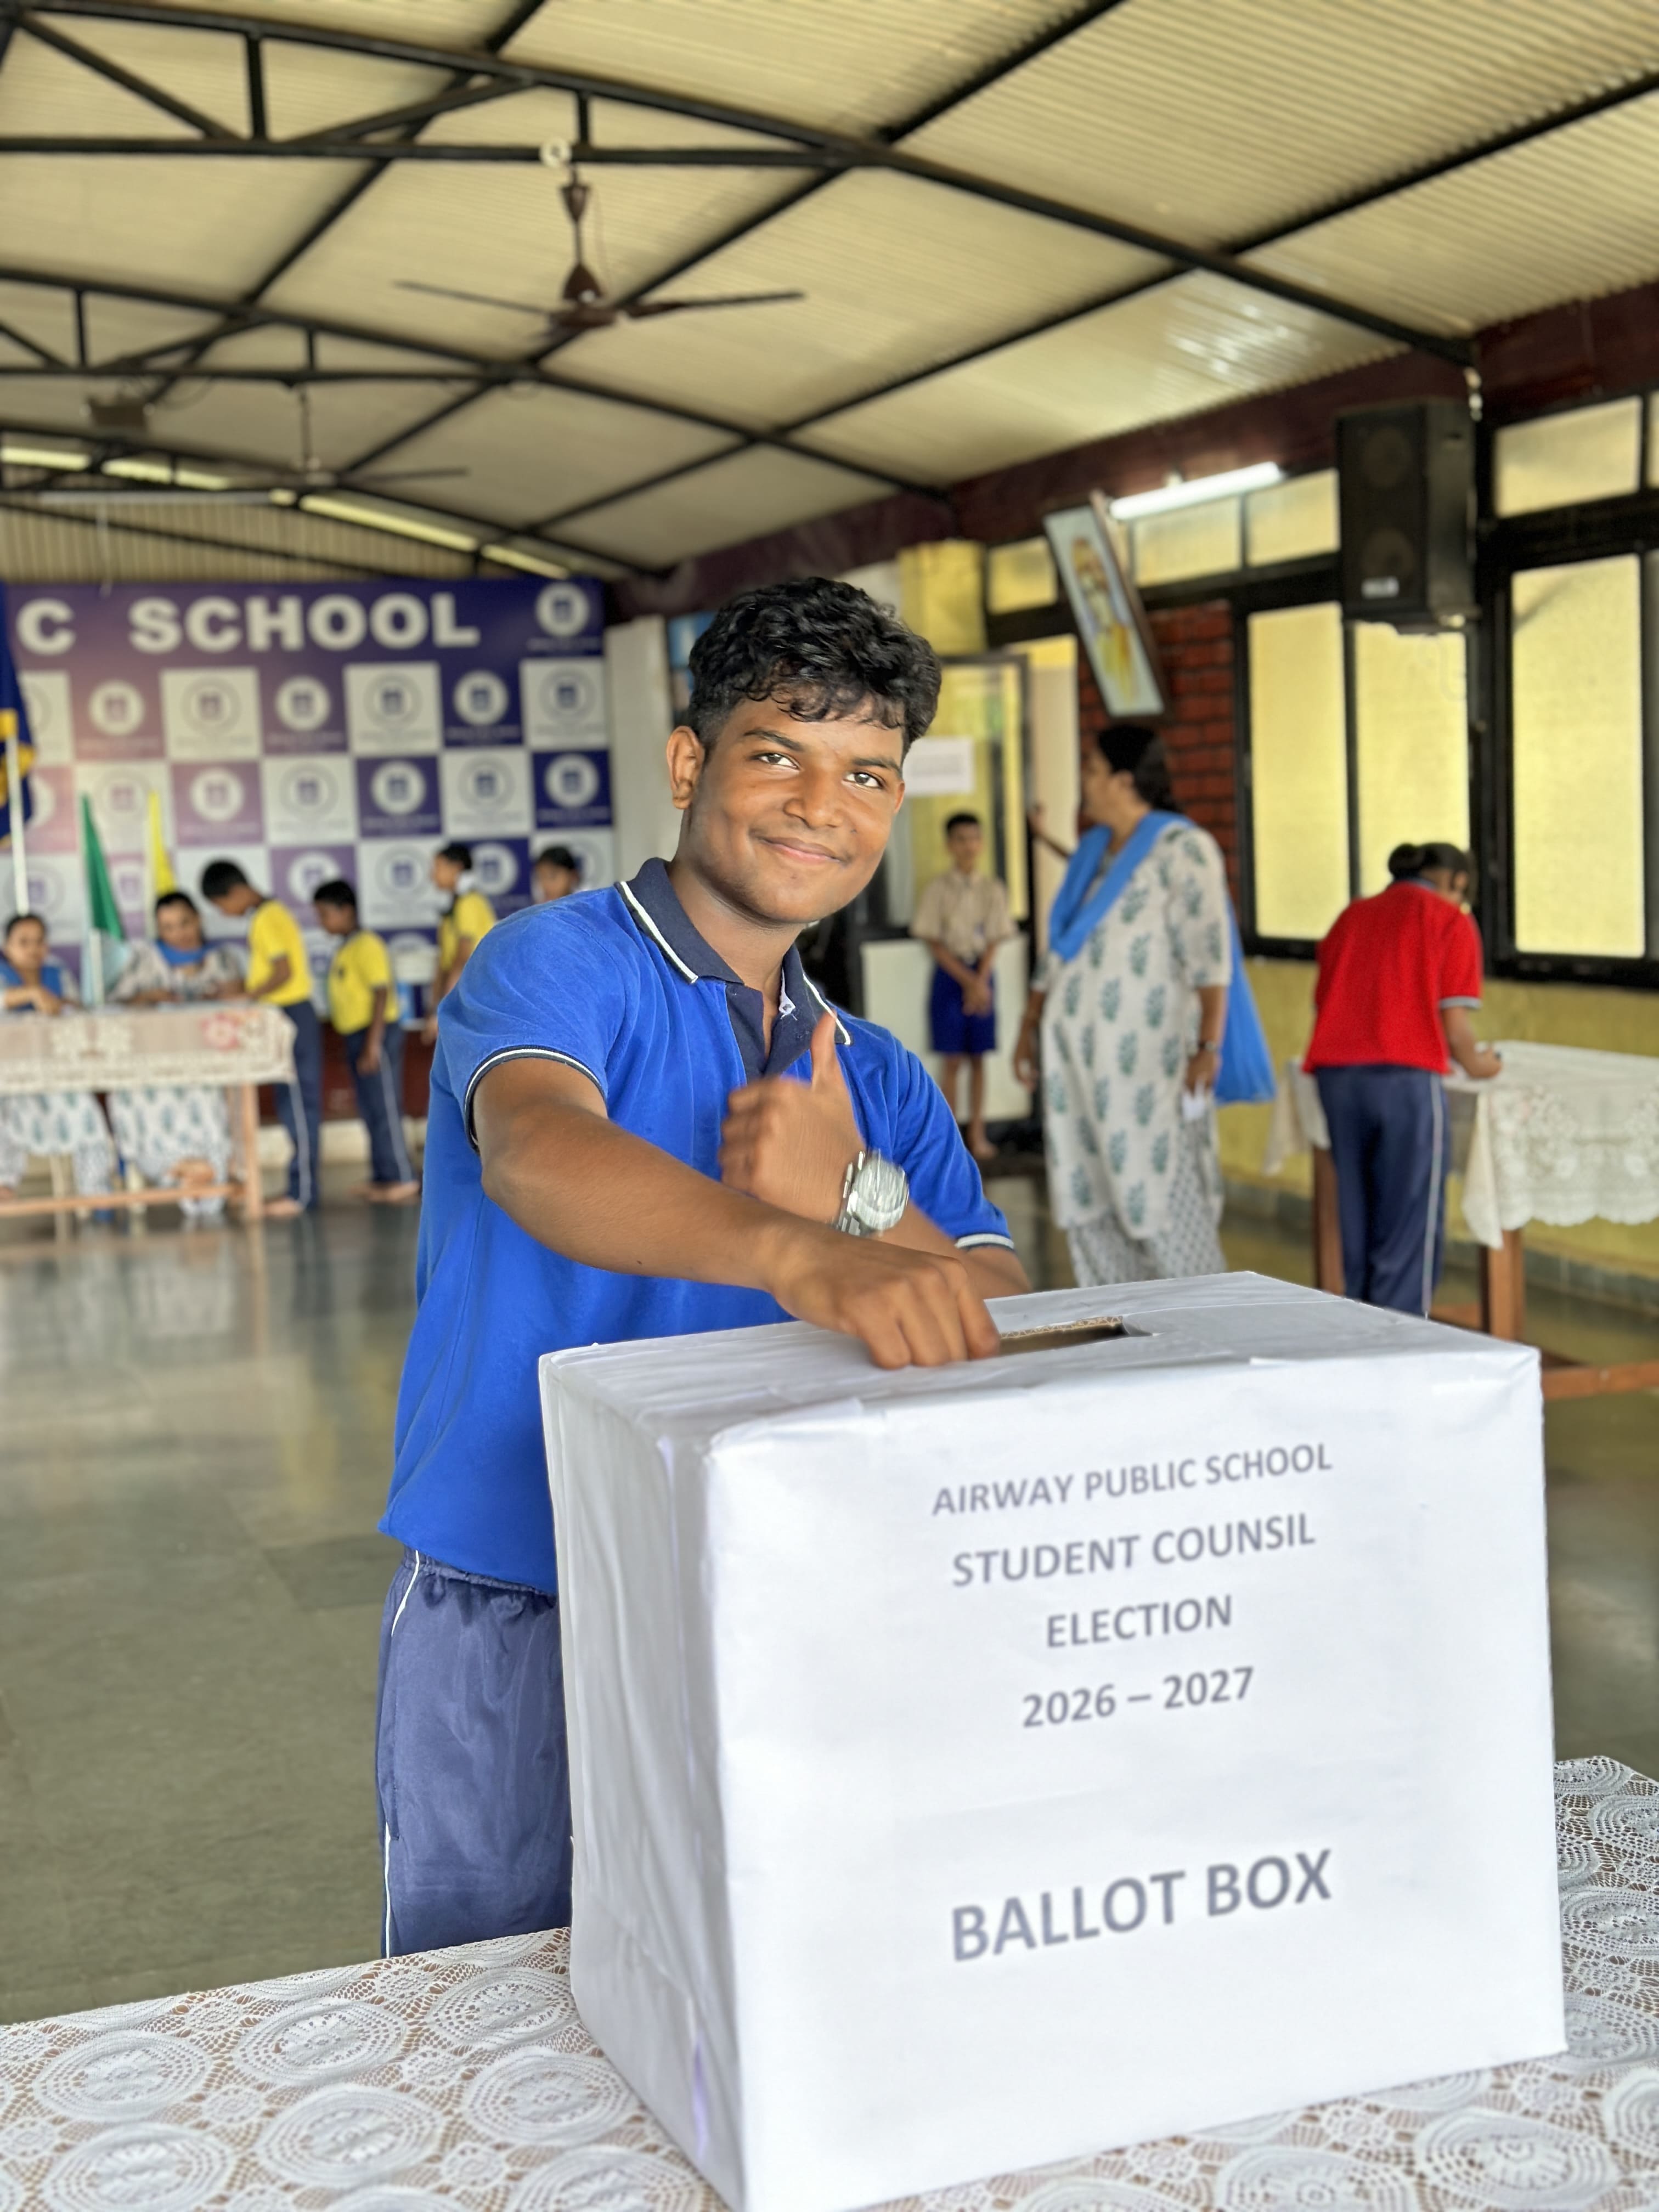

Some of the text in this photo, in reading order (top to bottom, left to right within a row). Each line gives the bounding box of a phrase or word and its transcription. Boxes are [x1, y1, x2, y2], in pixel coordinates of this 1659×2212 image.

[128, 593, 480, 653] SCHOOL
[931, 1443, 1333, 1516] AIRWAY PUBLIC SCHOOL
[952, 1513, 1316, 1587] STUDENT COUNSIL
[1046, 1594, 1232, 1649] ELECTION
[1023, 1684, 1116, 1728] 2026
[1163, 1666, 1254, 1709] 2027
[952, 1849, 1332, 1962] BALLOT BOX
